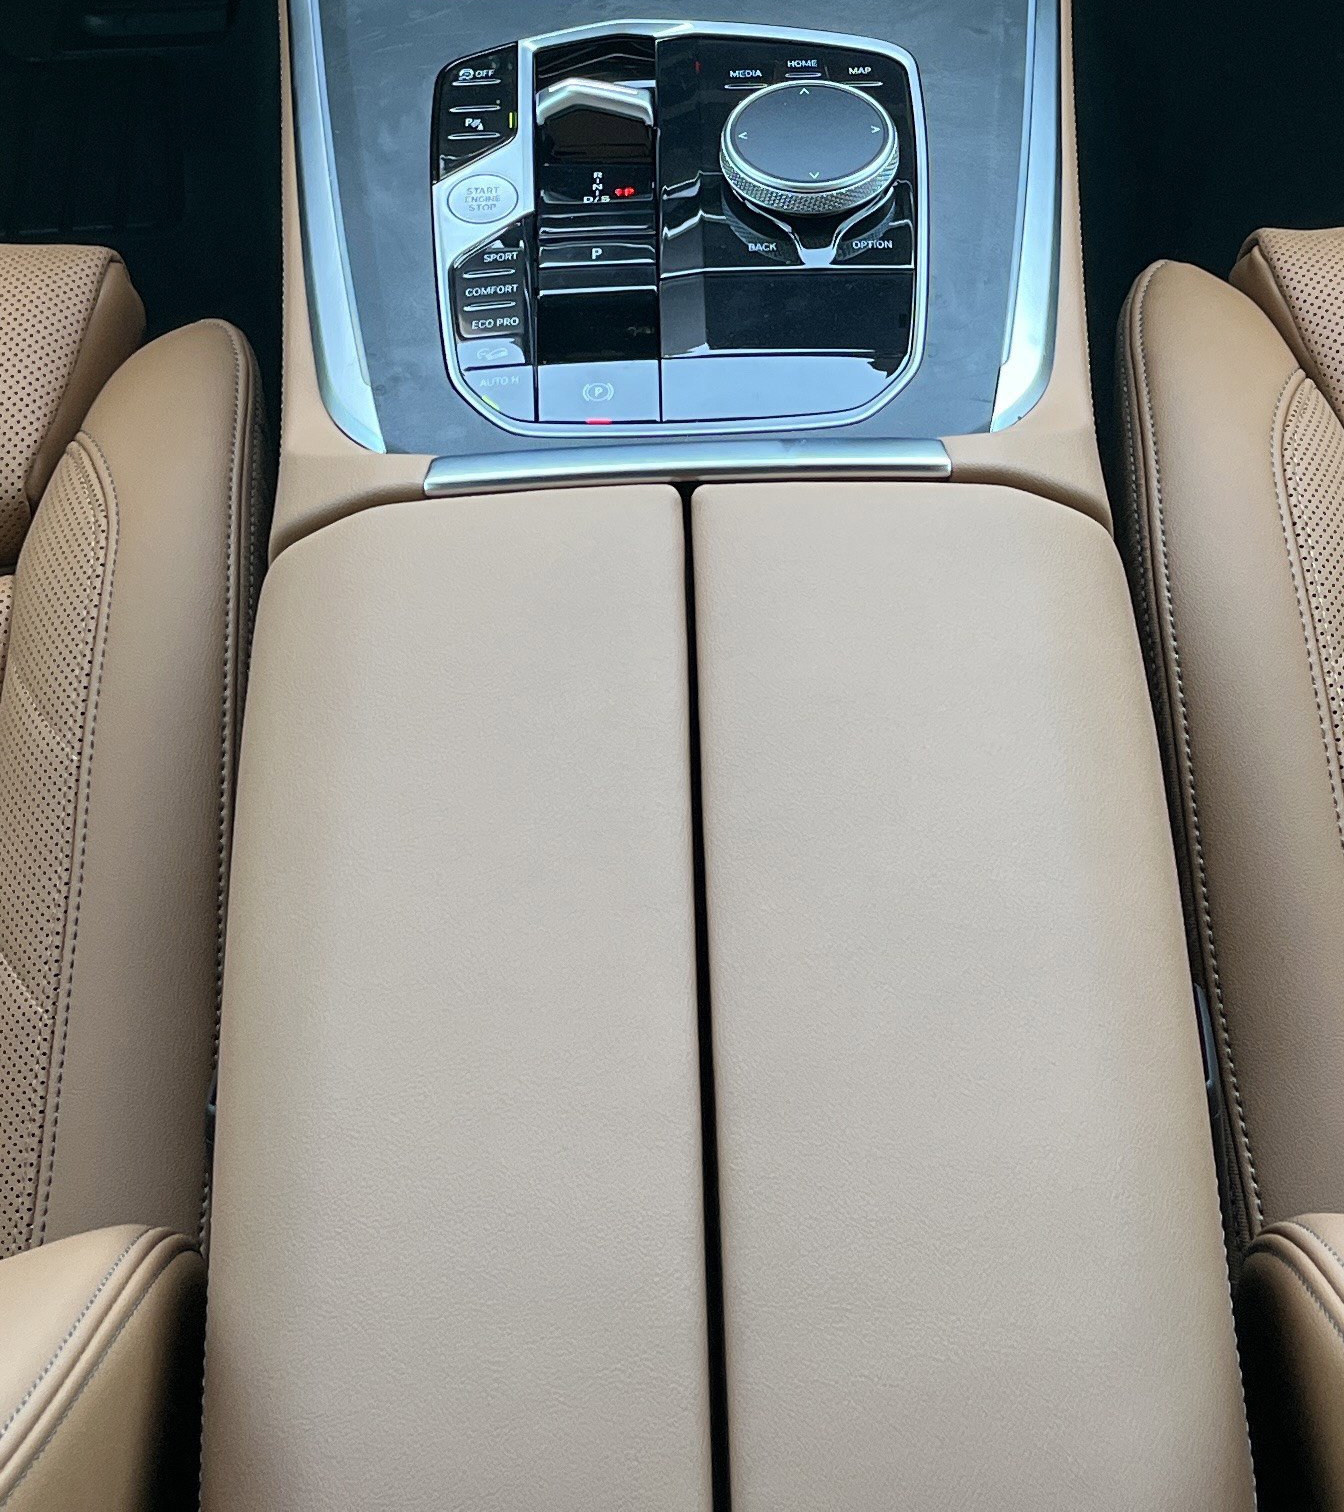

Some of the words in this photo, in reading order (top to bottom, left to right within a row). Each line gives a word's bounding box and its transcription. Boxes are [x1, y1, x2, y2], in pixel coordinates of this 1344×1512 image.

[787, 59, 818, 68] HOME
[475, 69, 495, 78] OFF
[729, 69, 763, 78] MEDIA
[848, 66, 872, 75] MAP
[466, 186, 500, 195] START
[464, 194, 501, 204] ENGINE
[468, 203, 497, 212] STOP
[748, 242, 777, 252] BACK
[852, 240, 893, 249] OPTION
[483, 251, 518, 263] SPORT
[591, 247, 603, 260] P
[465, 284, 519, 297] COMFORT
[471, 318, 494, 330] ECO
[496, 317, 520, 328] PRO
[479, 375, 508, 387] AUTO
[510, 375, 520, 386] H
